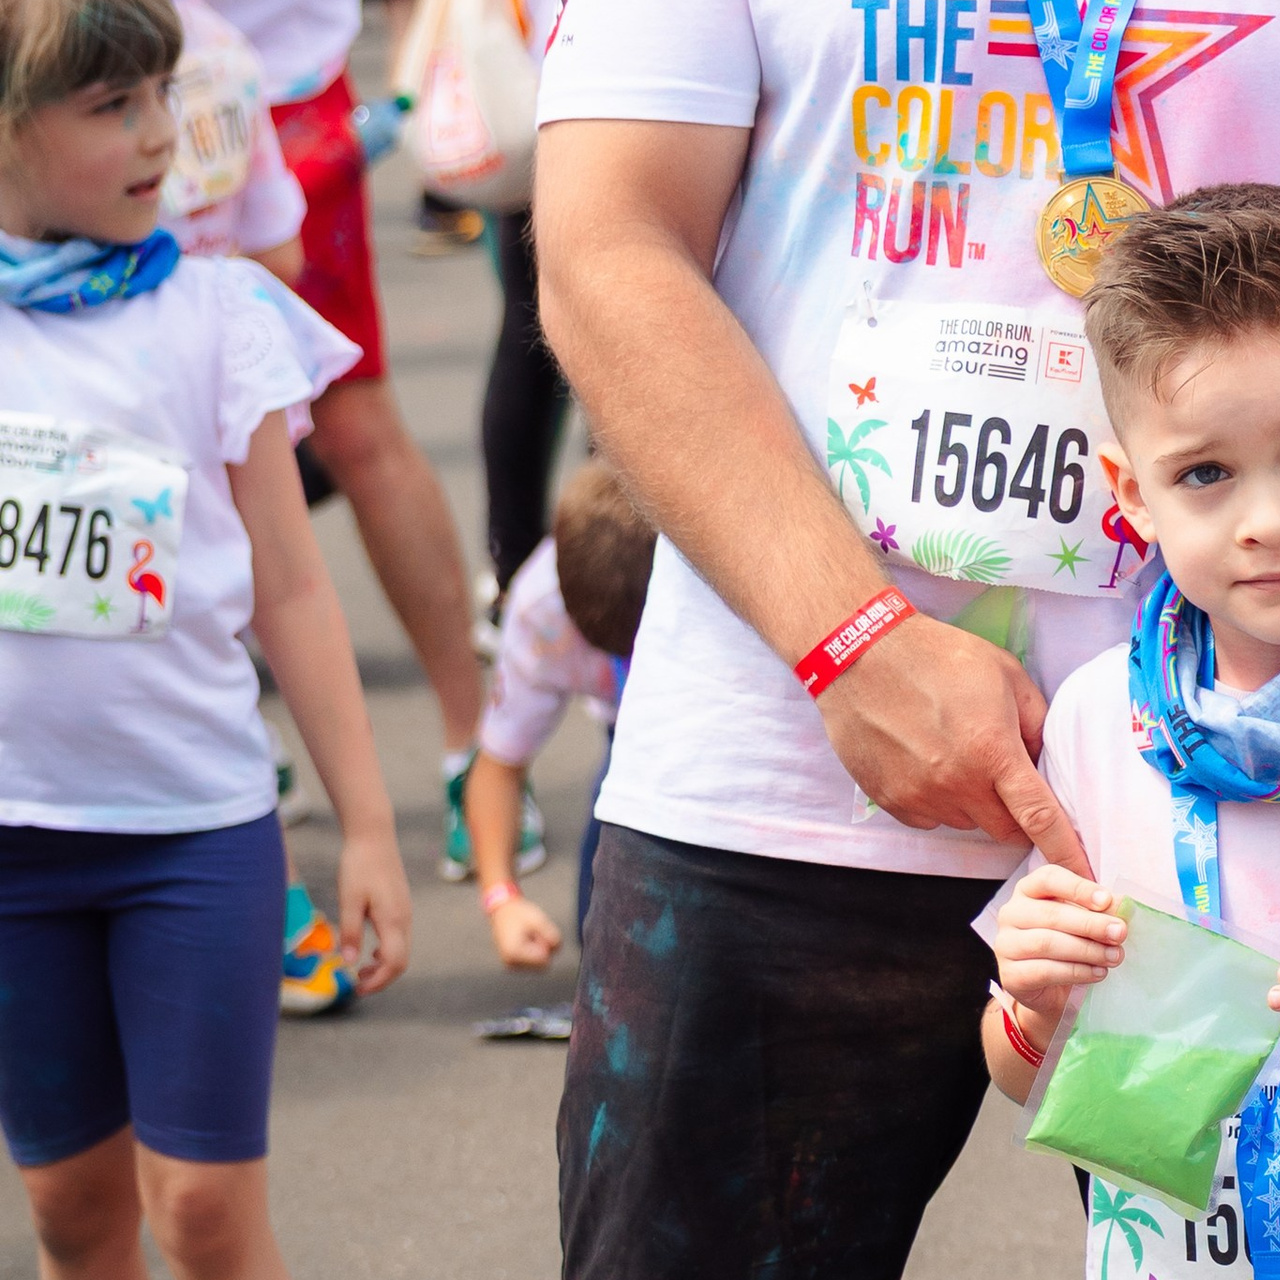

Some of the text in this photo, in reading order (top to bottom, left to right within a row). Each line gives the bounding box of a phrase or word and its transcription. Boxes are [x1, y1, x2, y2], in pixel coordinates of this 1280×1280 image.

[1091, 5, 1119, 51] COLOR
[1085, 52, 1106, 79] THE
[851, 85, 1060, 179] COLOR
[851, 172, 971, 269] RUN
[940, 319, 959, 335] THE
[961, 319, 1003, 339] COLOR
[935, 340, 1029, 366] amazing
[944, 356, 987, 376] tour
[910, 409, 1091, 525] 15646
[823, 637, 846, 659] THE
[840, 614, 873, 646] COLOR
[840, 621, 885, 661] amazing tour
[1193, 883, 1211, 914] RUN
